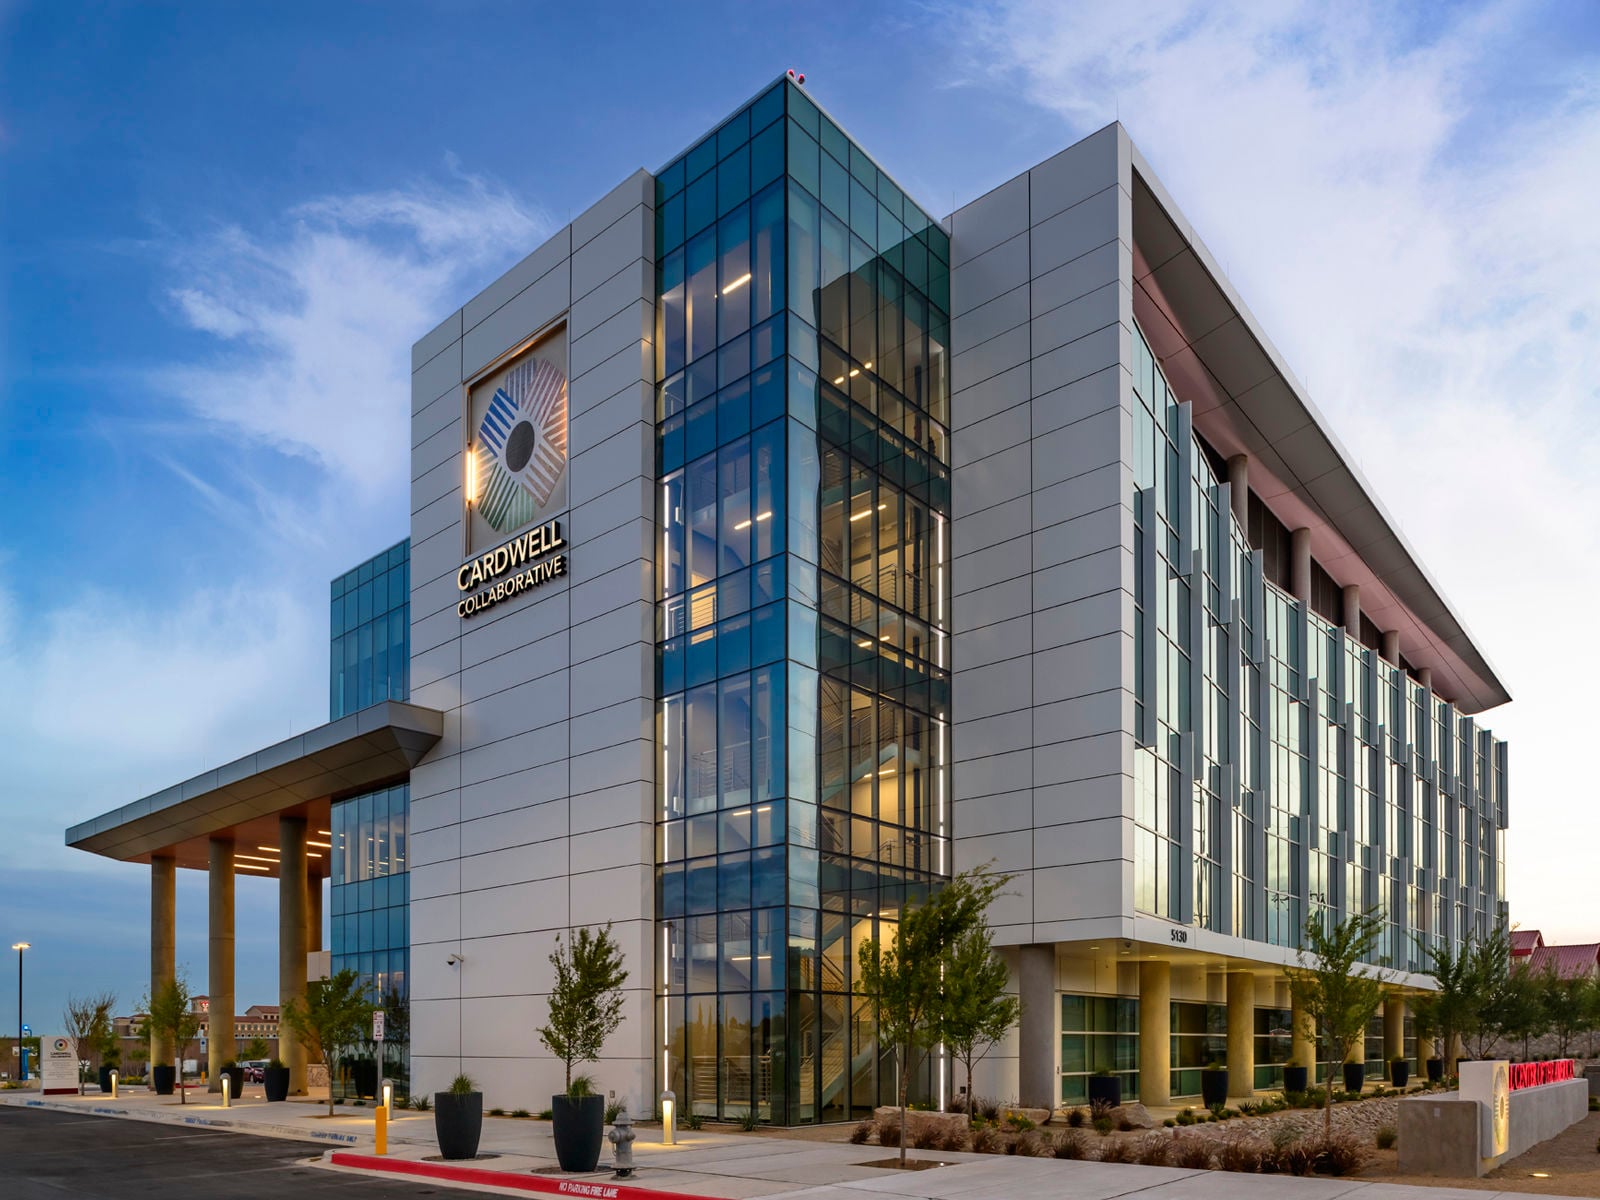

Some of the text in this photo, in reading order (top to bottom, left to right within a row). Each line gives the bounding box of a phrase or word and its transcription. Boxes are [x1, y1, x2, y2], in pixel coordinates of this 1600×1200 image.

[457, 520, 563, 591] CARDWELL
[457, 555, 563, 618] COLLABORATIVE
[1171, 929, 1187, 943] 5130
[559, 1182, 619, 1198] NO PARKING FIRE LANE
